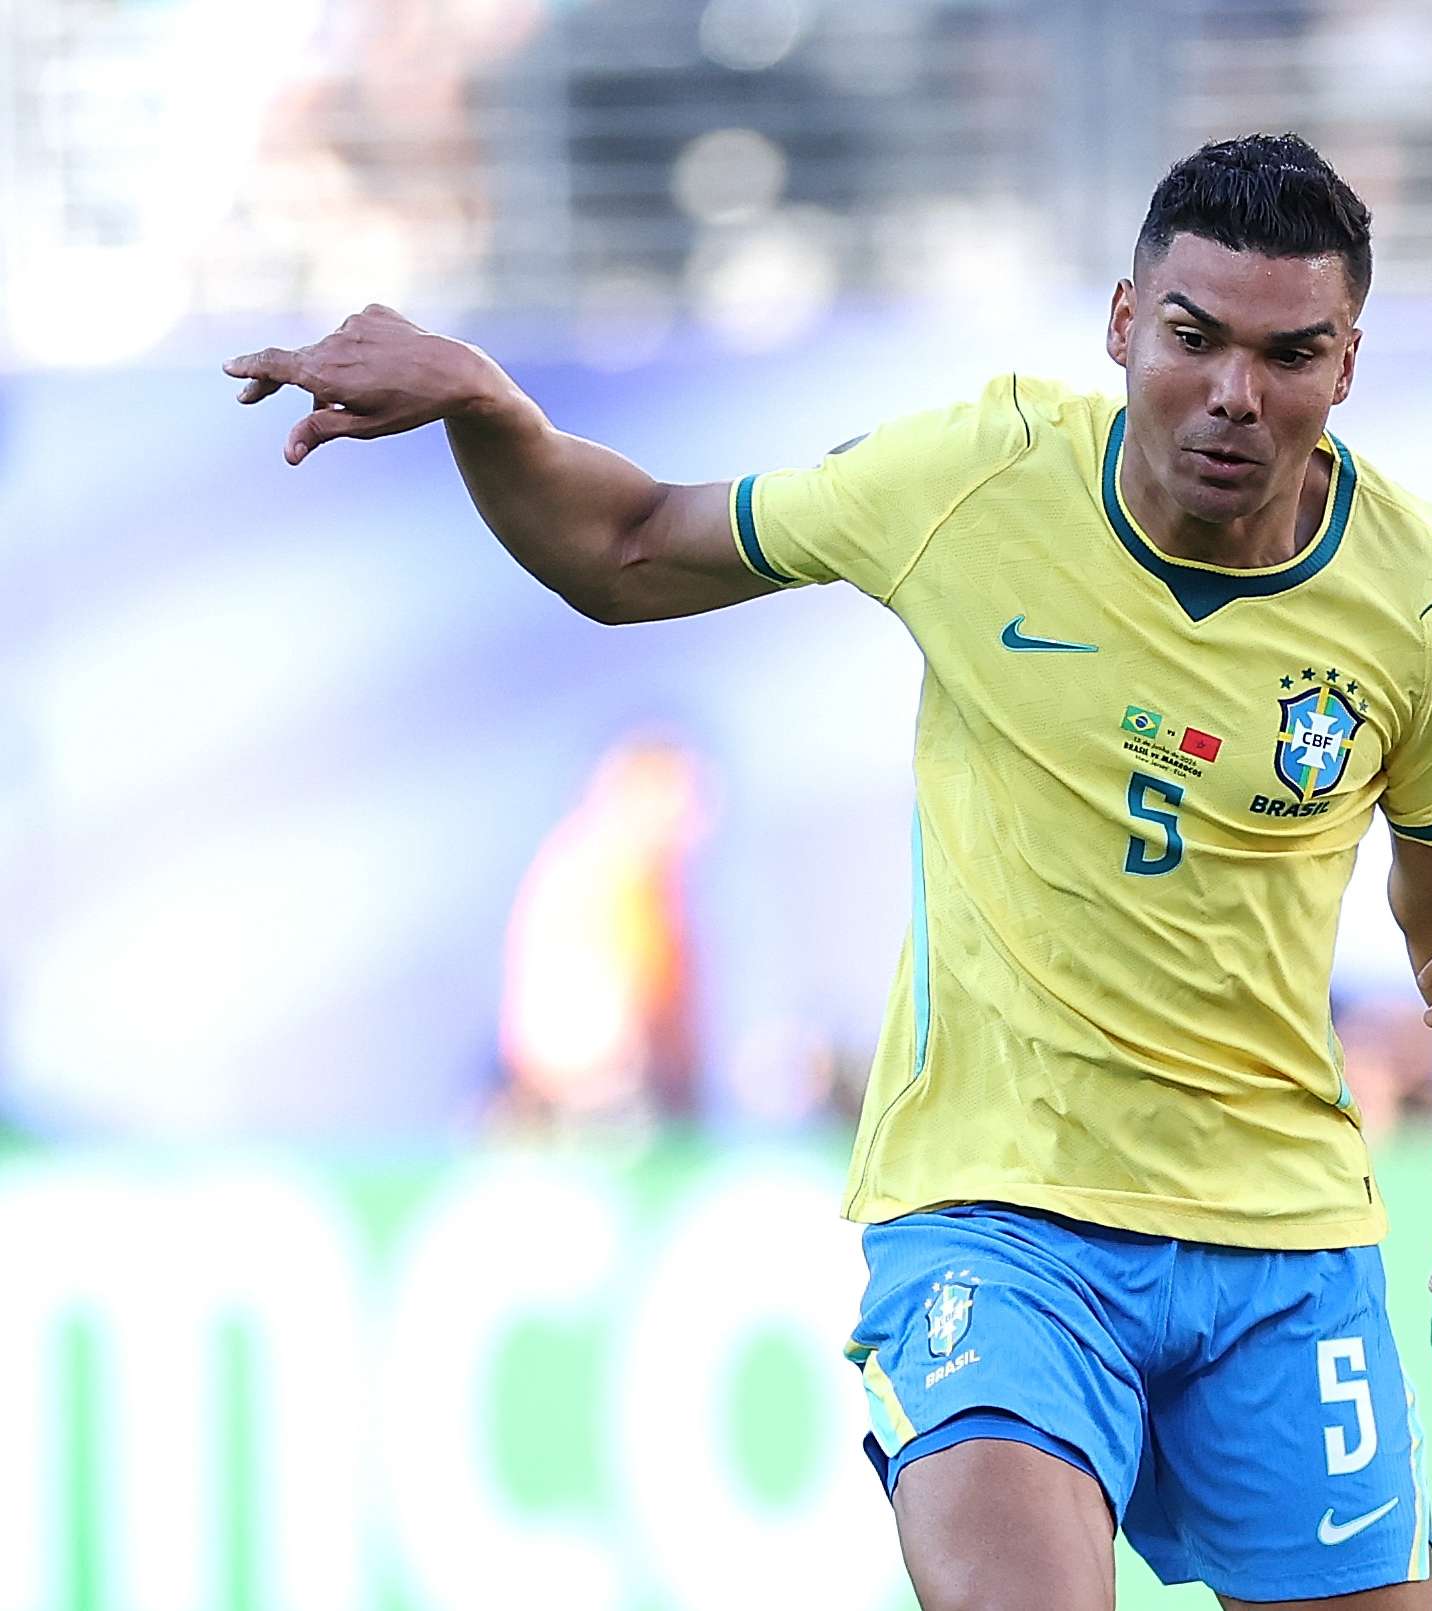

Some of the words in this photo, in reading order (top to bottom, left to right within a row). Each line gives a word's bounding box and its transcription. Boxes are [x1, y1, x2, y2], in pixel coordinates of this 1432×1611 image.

[1302, 731, 1333, 749] CBF
[1123, 741, 1149, 756] BRASIL
[1161, 755, 1202, 778] MARROCOS
[1124, 771, 1185, 876] 5
[1249, 794, 1330, 817] BRASIL
[925, 1349, 981, 1389] BRASIL
[1316, 1336, 1378, 1476] 5
